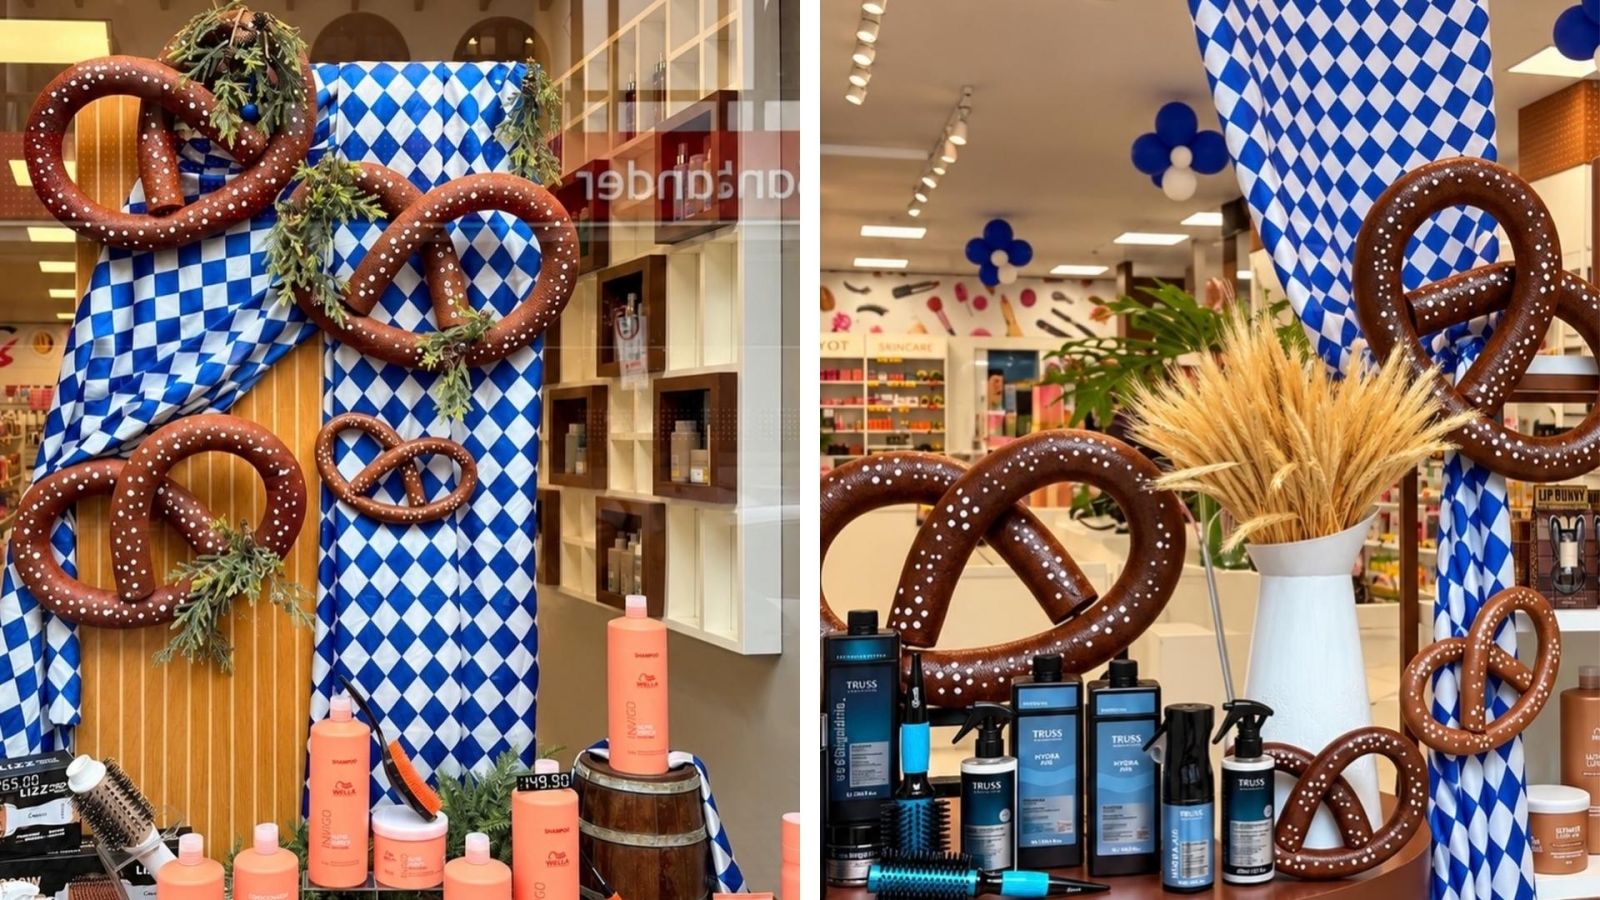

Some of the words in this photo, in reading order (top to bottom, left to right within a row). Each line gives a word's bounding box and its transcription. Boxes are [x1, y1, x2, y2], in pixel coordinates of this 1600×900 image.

[878, 342, 933, 352] SKINCARE
[846, 679, 878, 689] TRUSS
[1032, 729, 1063, 738] TRUSS
[1112, 735, 1142, 744] TRUSS
[0, 774, 39, 791] 65.00
[972, 781, 1002, 790] TRUSS
[1238, 778, 1265, 787] TRUSS
[20, 784, 48, 797] LIZZ
[321, 809, 332, 849] INVIGO
[545, 858, 569, 867] WELLA
